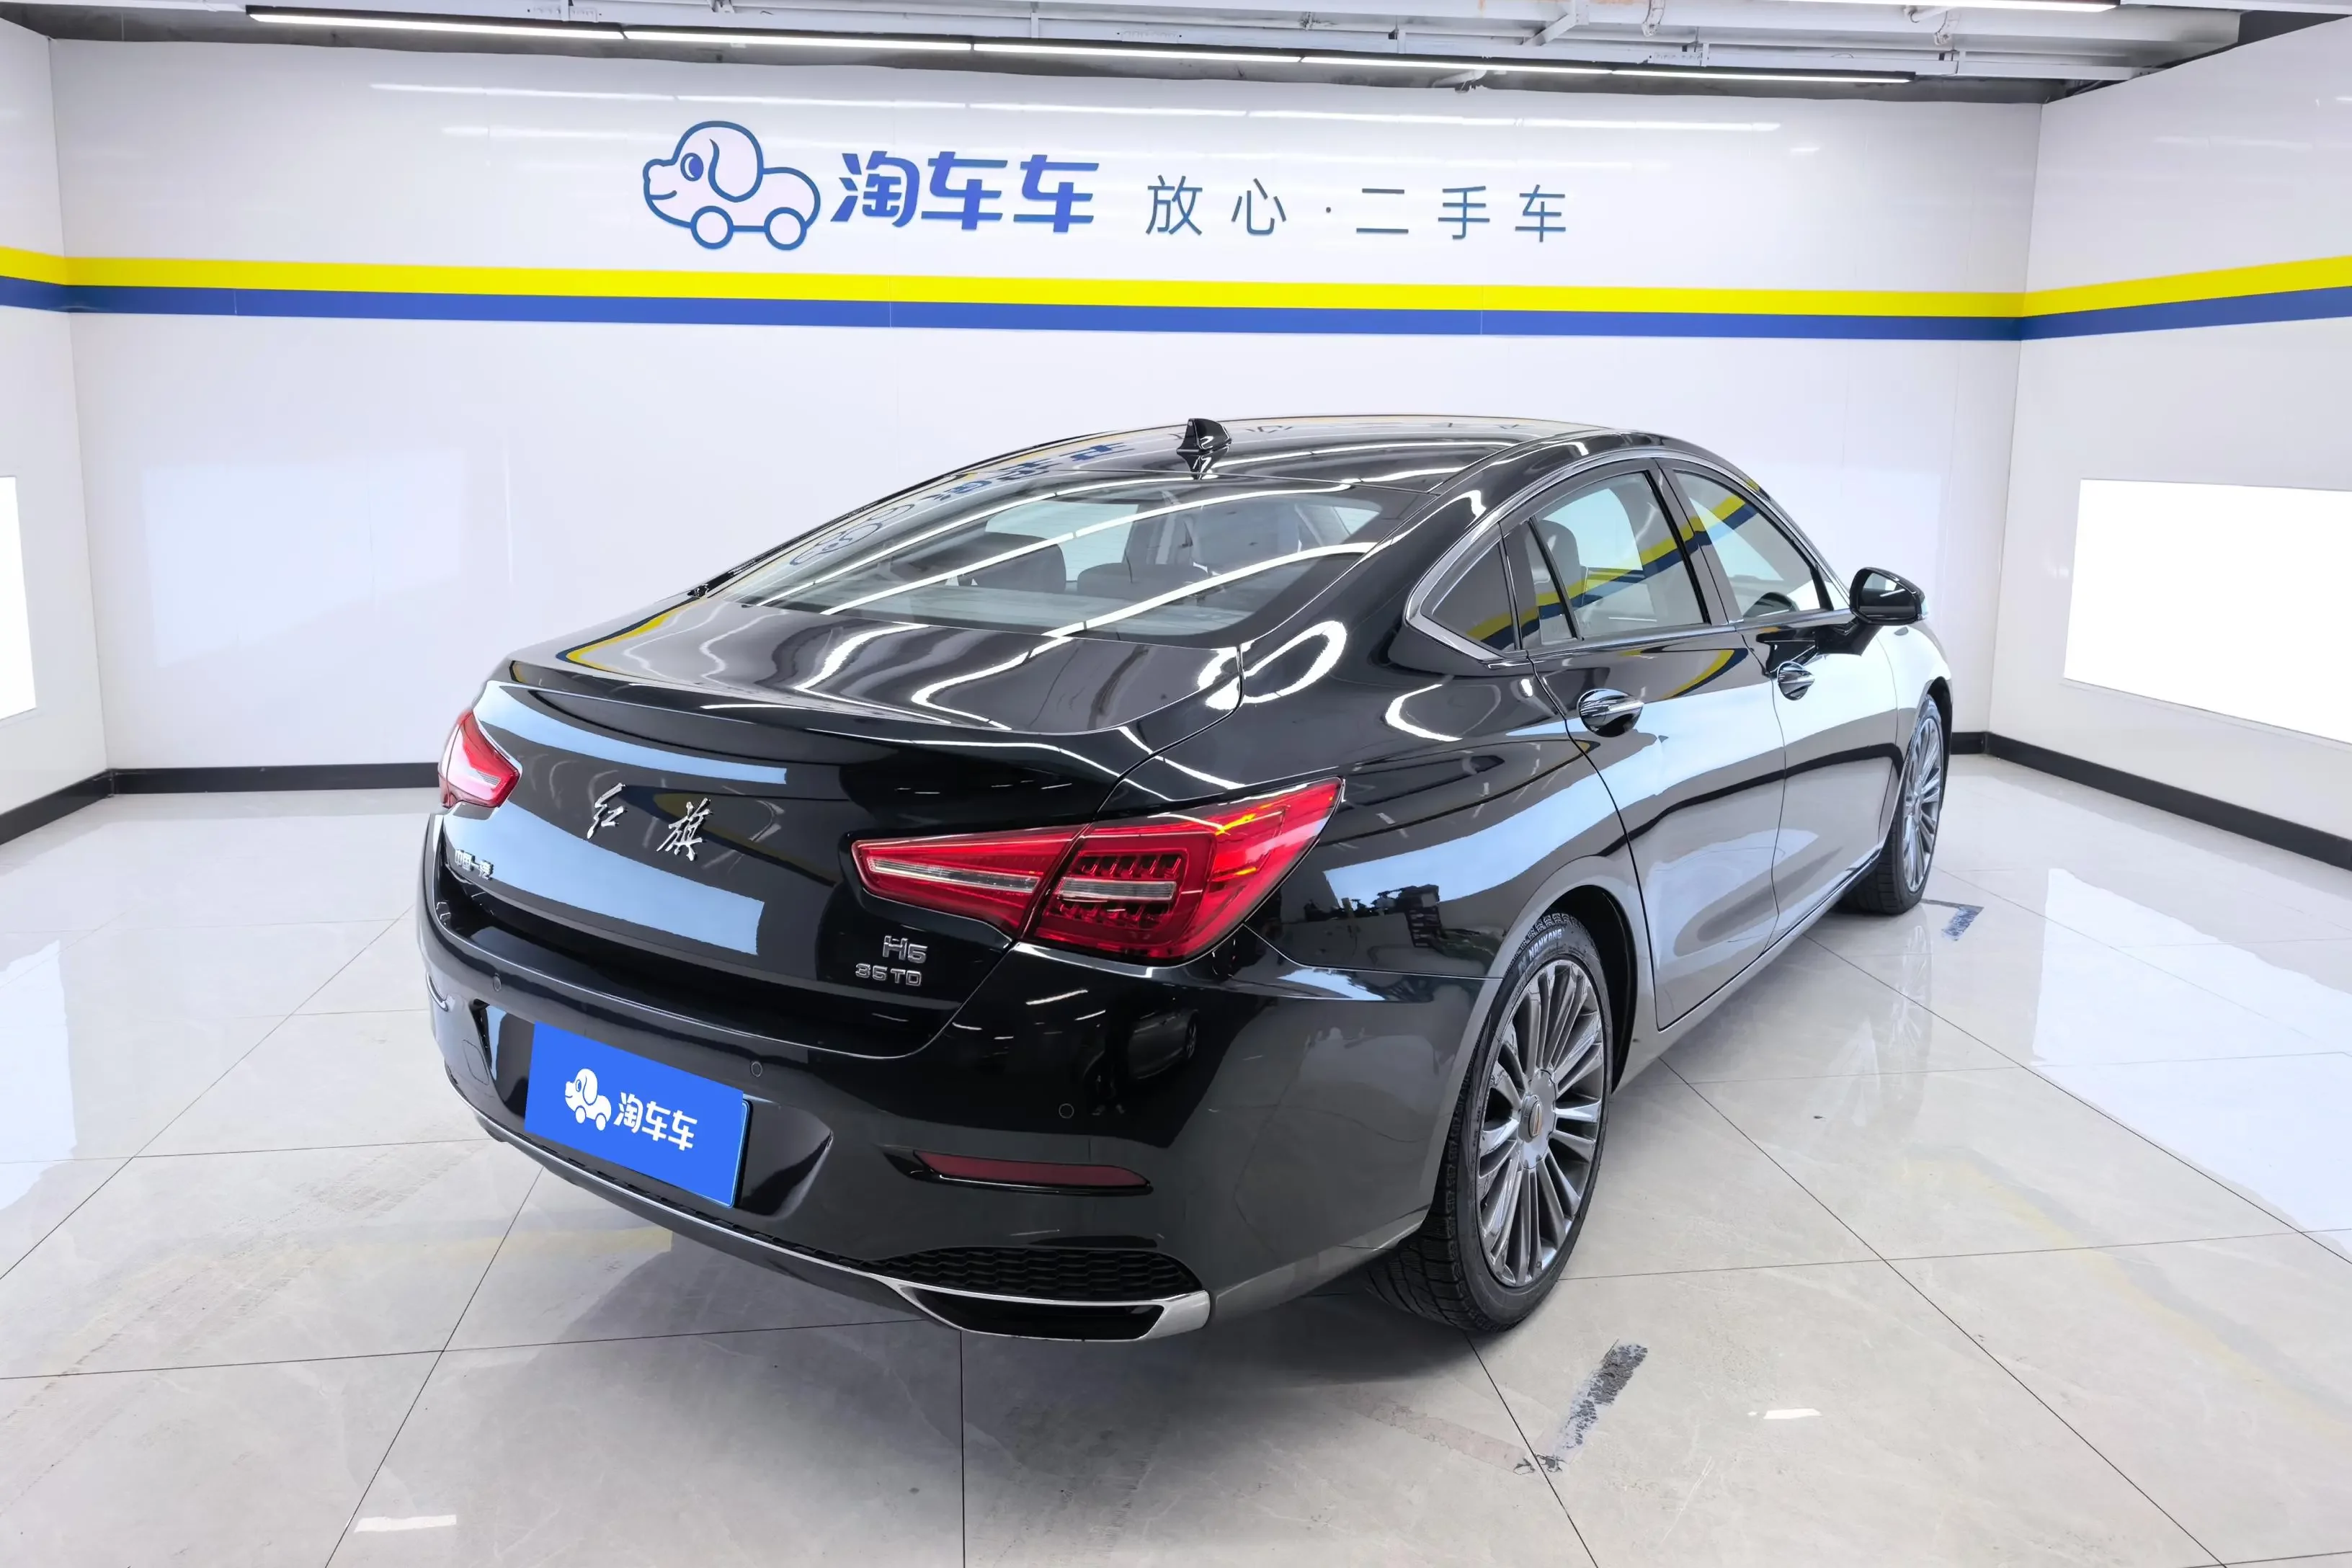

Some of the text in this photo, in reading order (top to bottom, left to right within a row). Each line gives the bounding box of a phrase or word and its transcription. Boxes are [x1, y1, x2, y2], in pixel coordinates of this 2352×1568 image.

[830, 150, 1100, 233] 淘车车
[882, 935, 928, 963] H5
[1528, 928, 1562, 961] NANKANG
